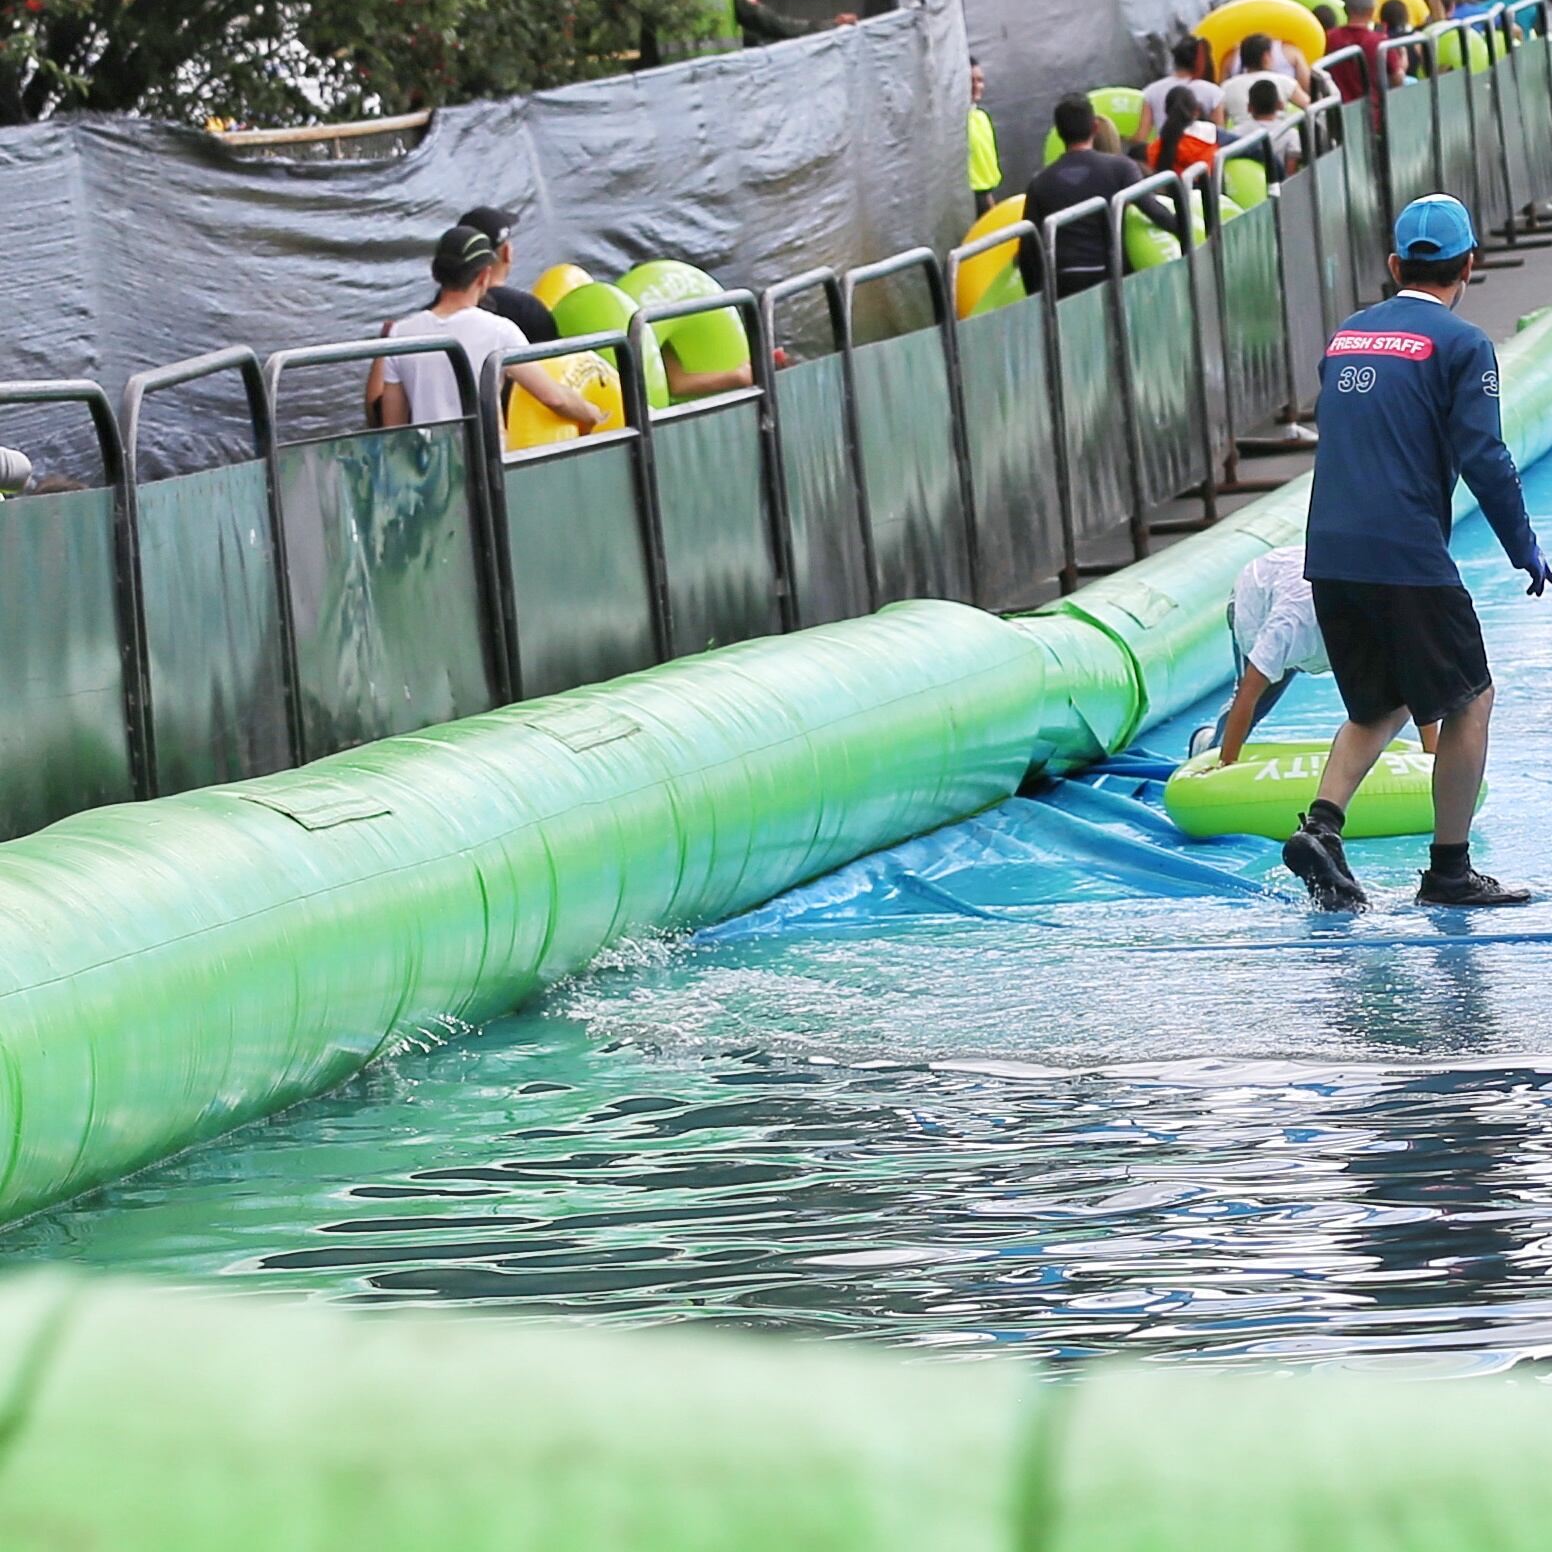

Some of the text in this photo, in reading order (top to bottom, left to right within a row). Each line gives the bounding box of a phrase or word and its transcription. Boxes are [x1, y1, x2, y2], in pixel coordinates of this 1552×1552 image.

[1330, 336, 1425, 354] FRESH STAFF
[1337, 366, 1376, 393] 39
